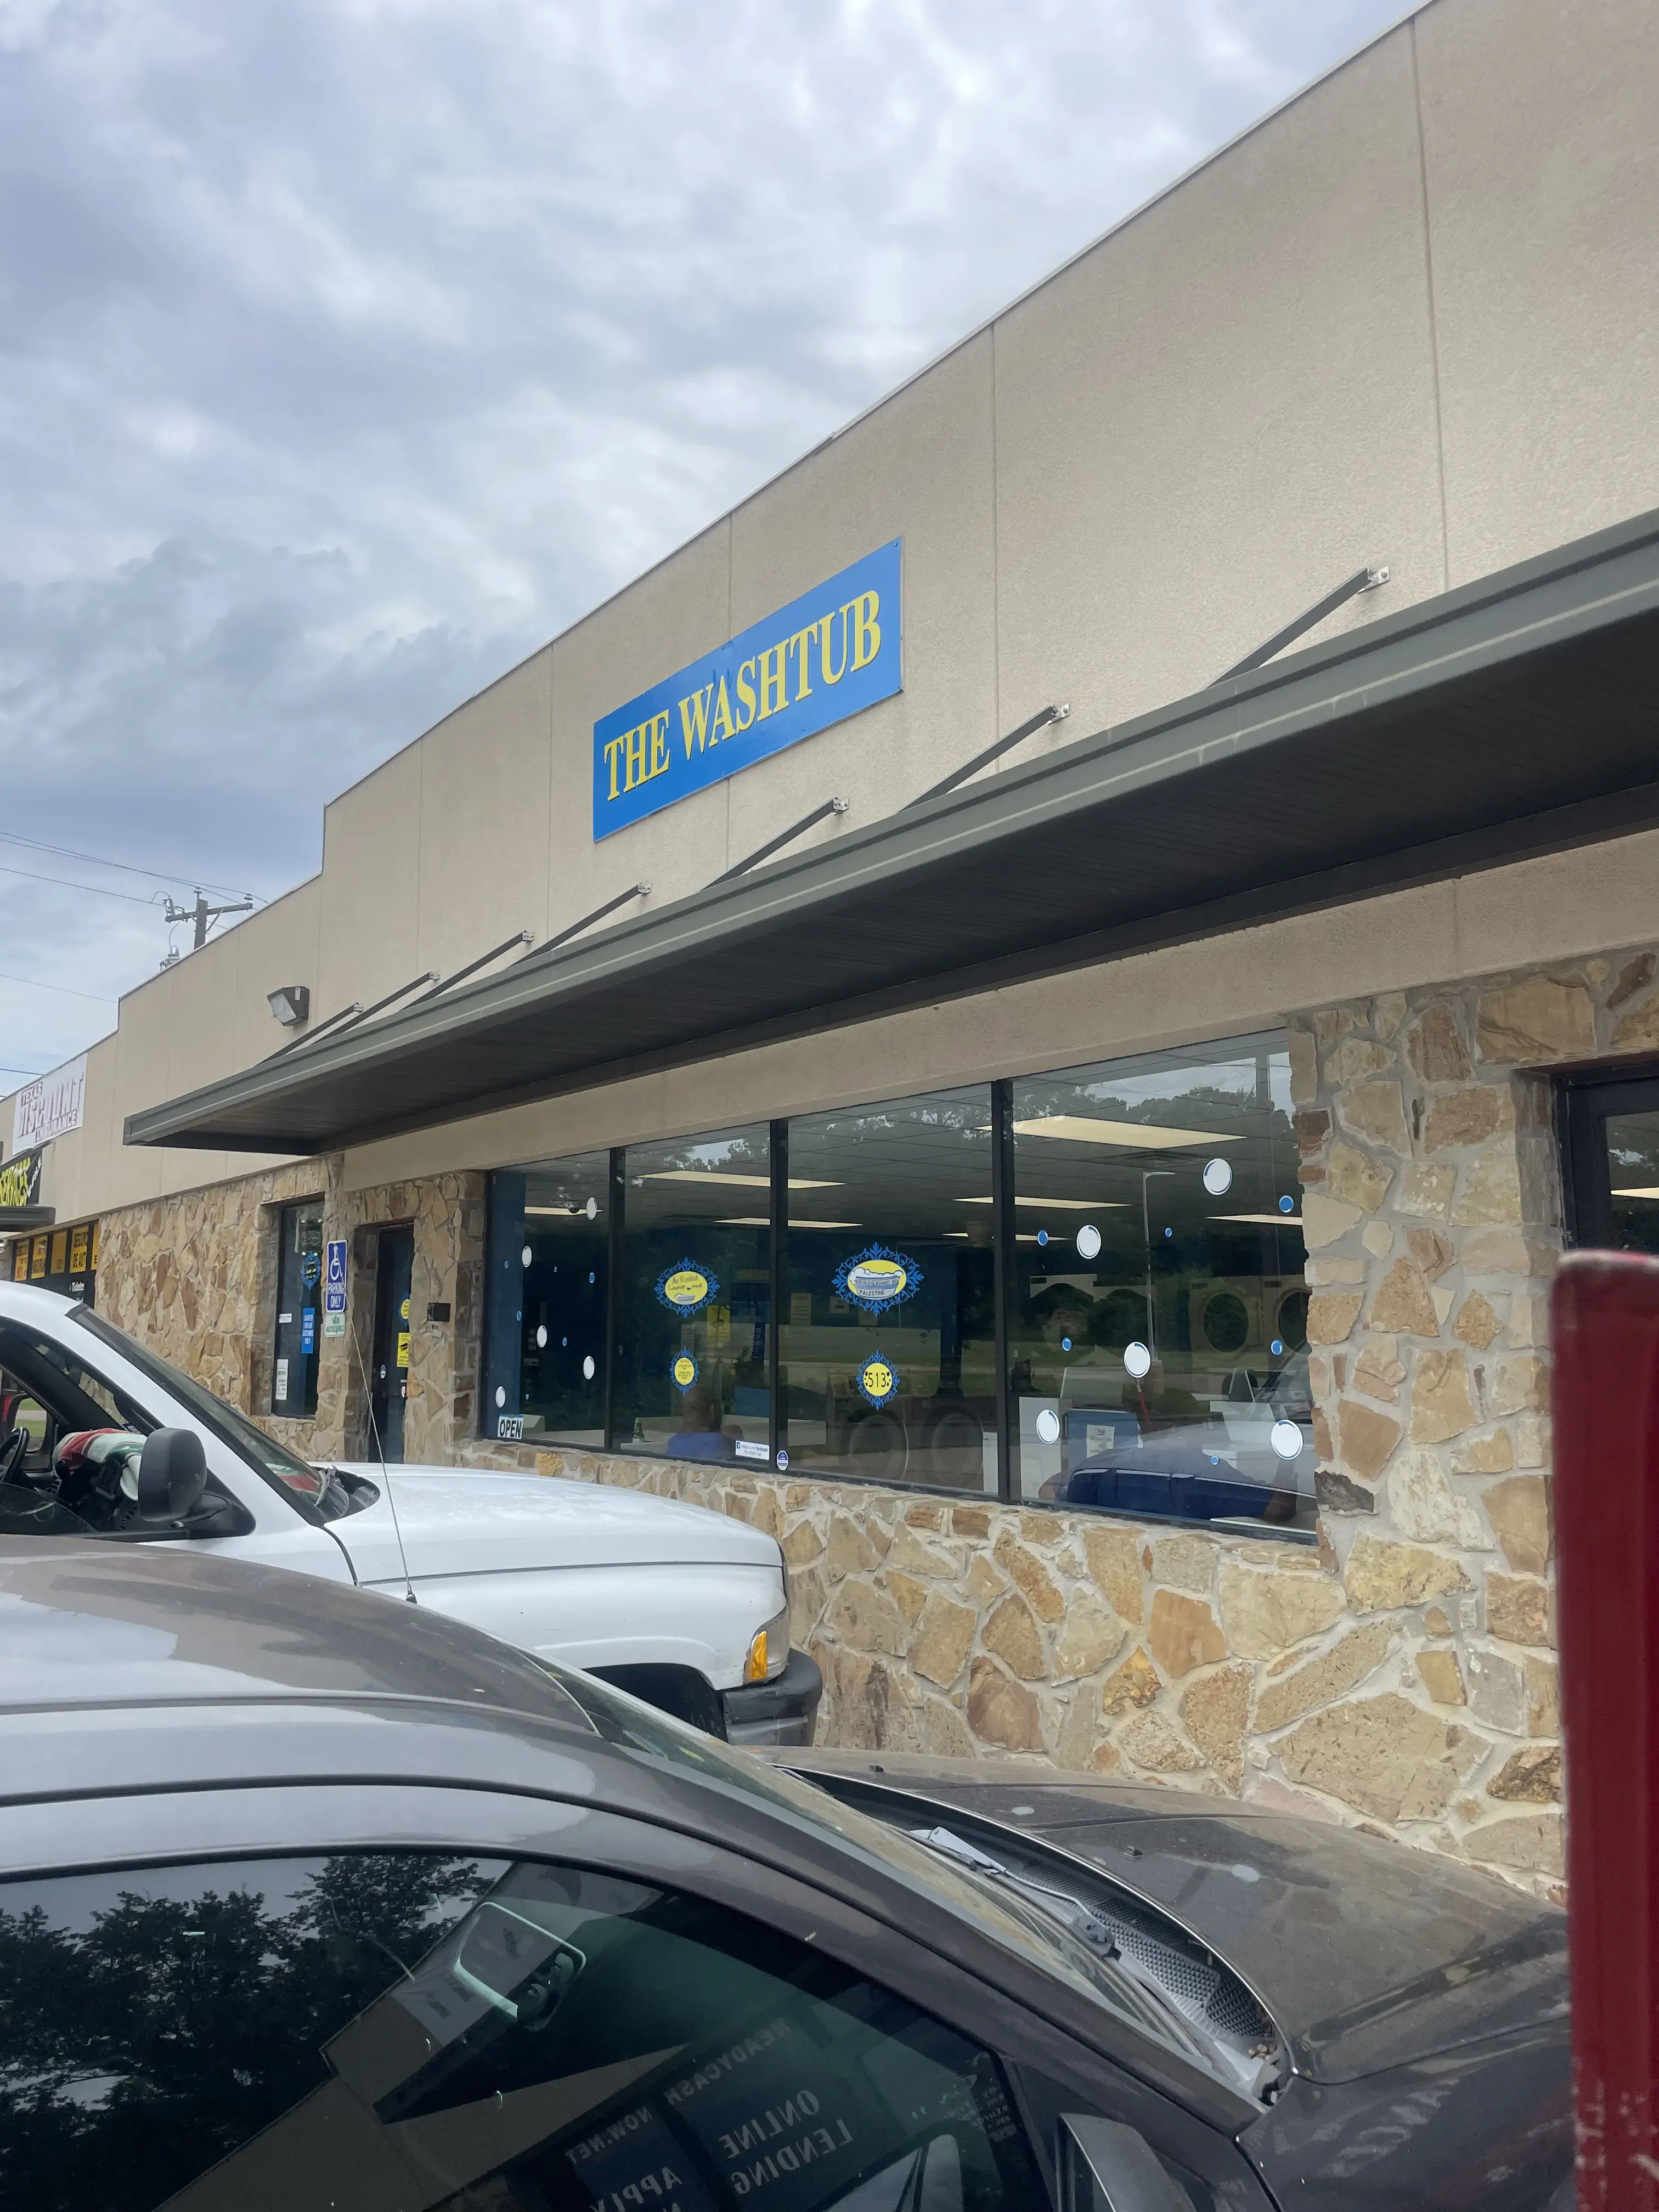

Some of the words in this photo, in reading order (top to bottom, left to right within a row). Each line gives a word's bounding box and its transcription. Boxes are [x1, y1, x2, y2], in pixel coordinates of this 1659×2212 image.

[605, 709, 670, 801] THE
[678, 590, 882, 761] WASHTUB
[22, 1082, 42, 1105] TEXAS
[18, 1072, 83, 1138] DISCOUNT
[36, 1109, 77, 1142] INSURANCE
[328, 1282, 345, 1295] PARKING
[330, 1295, 341, 1308] ONLY
[332, 1316, 340, 1325] VAN
[868, 1372, 886, 1387] 513
[500, 1419, 522, 1438] OPEN
